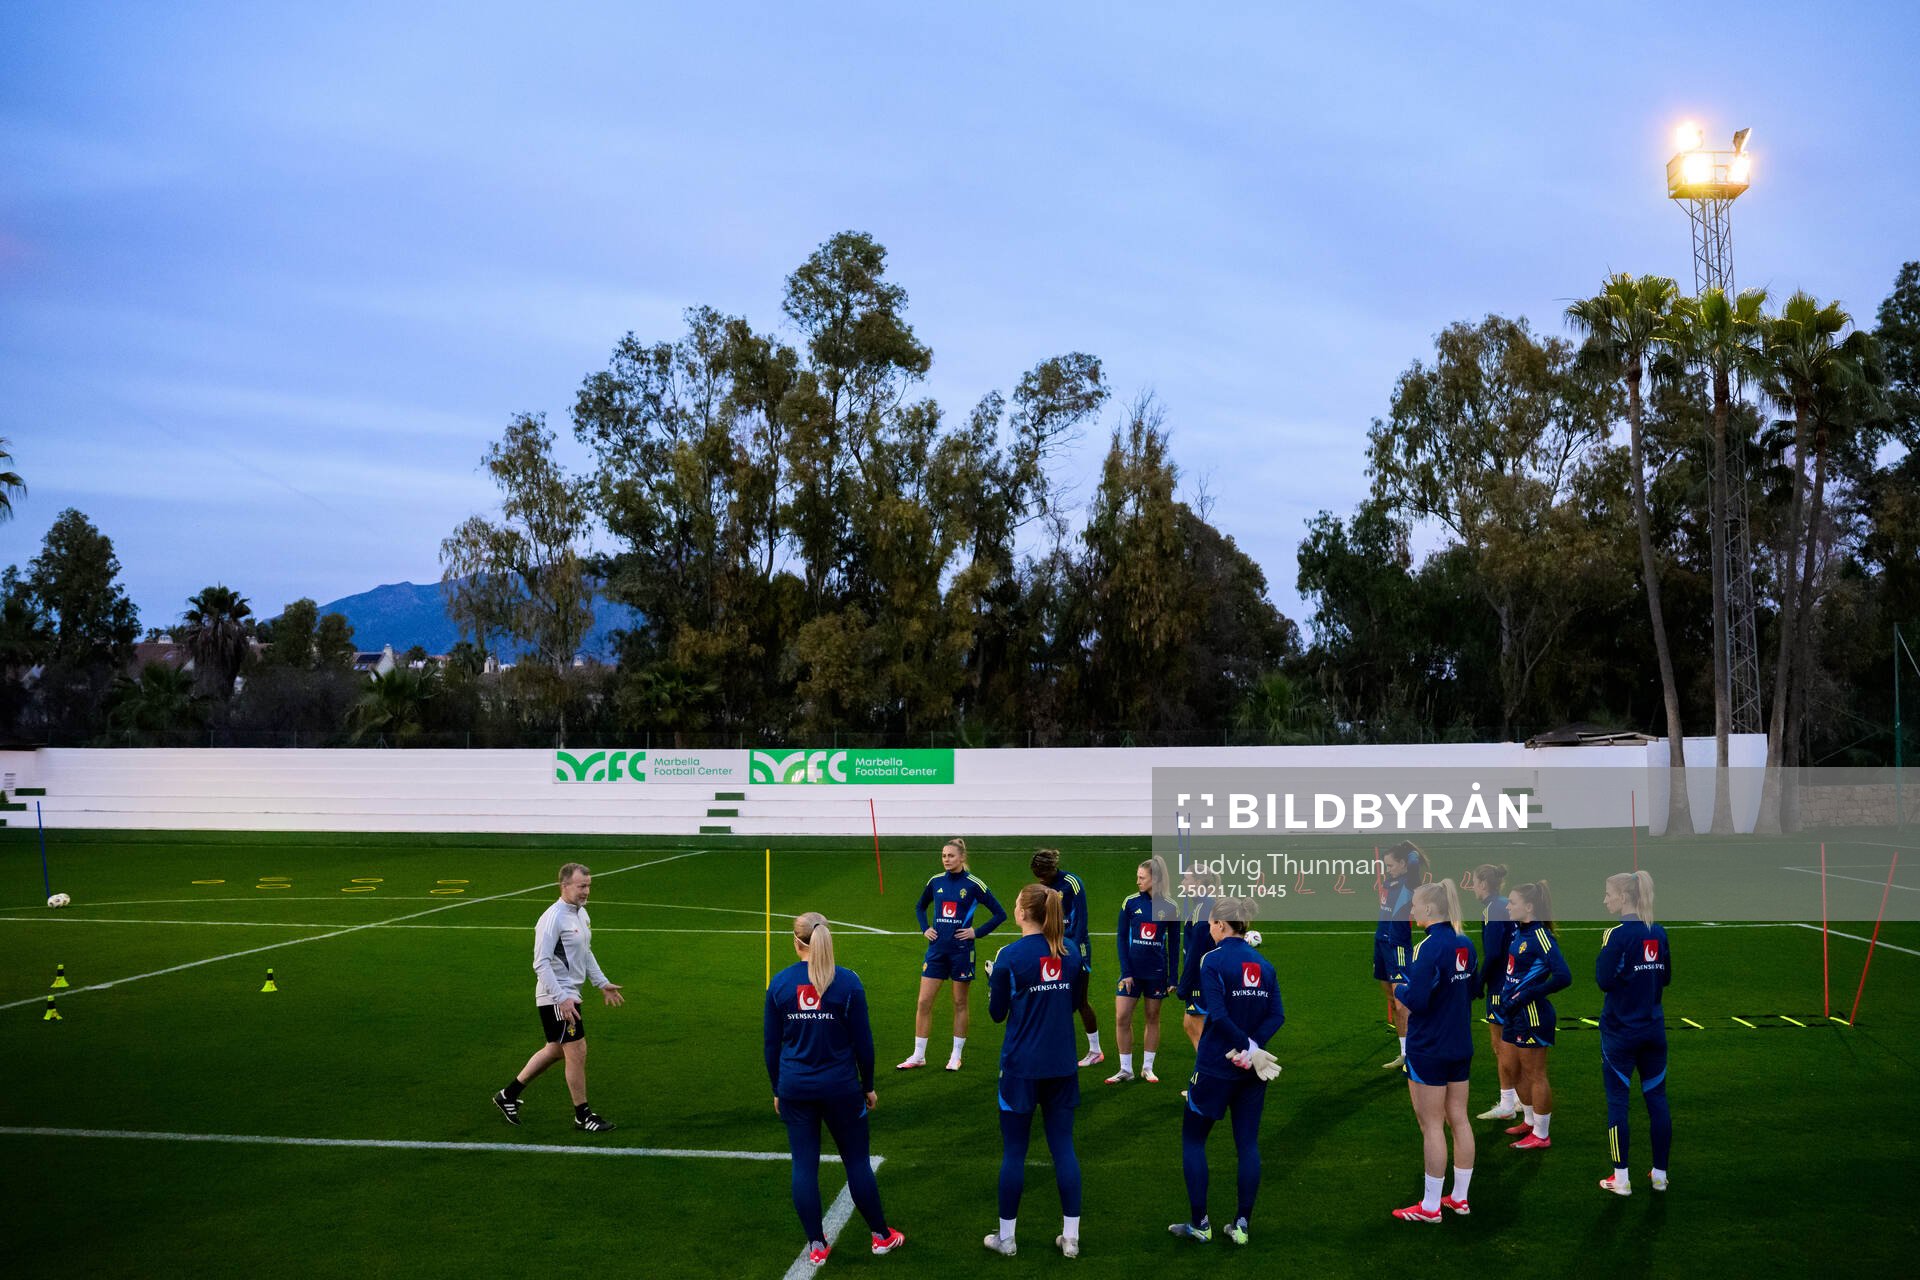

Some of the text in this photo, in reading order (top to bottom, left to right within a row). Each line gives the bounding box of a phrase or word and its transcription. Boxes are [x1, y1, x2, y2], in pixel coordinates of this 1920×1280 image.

[654, 757, 700, 767] Marbella
[855, 757, 903, 767] Marbella
[654, 766, 733, 776] Football Center
[855, 766, 937, 777] Football Center
[1058, 982, 1070, 990] SPE
[786, 1012, 835, 1020] SVENSKA SPEL
